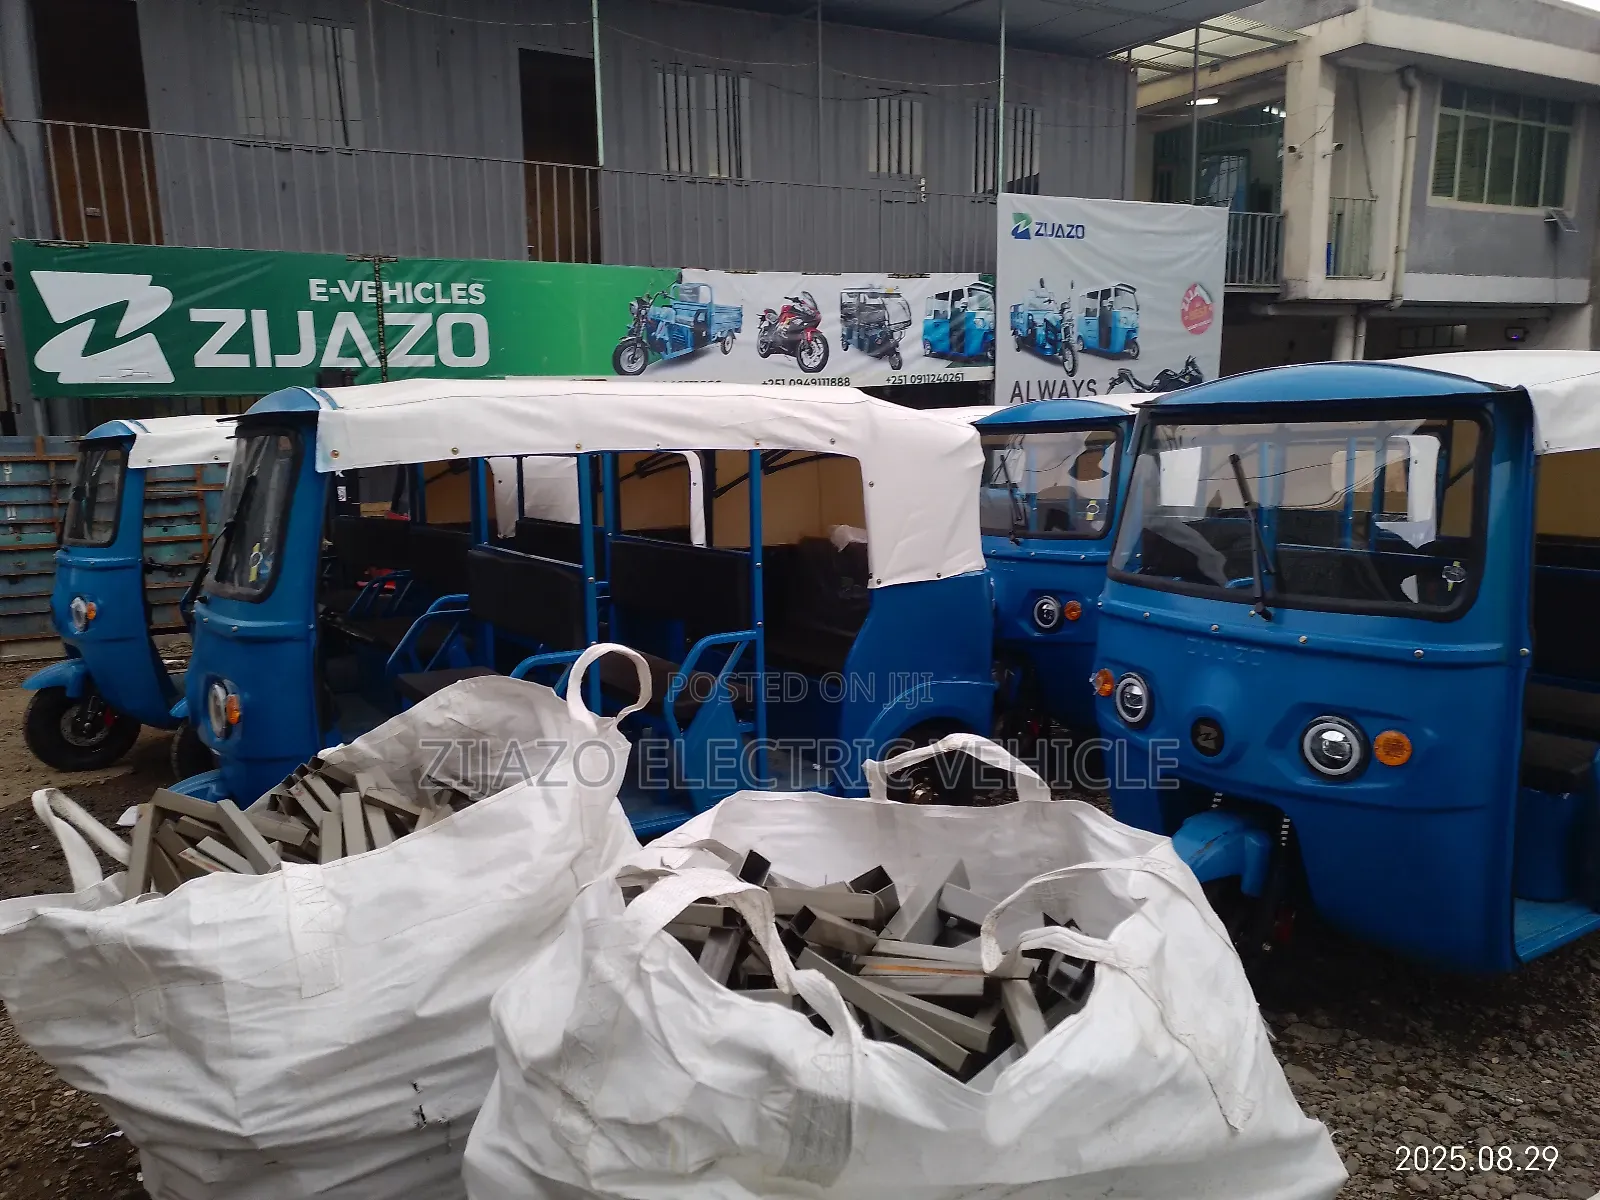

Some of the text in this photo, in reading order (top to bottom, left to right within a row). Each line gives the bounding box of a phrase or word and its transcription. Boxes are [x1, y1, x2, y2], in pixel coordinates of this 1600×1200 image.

[308, 278, 487, 305] E-VEHICLES
[189, 308, 490, 368] ZIJAZO
[885, 374, 907, 385] +251
[1009, 378, 1097, 403] ALWAYS
